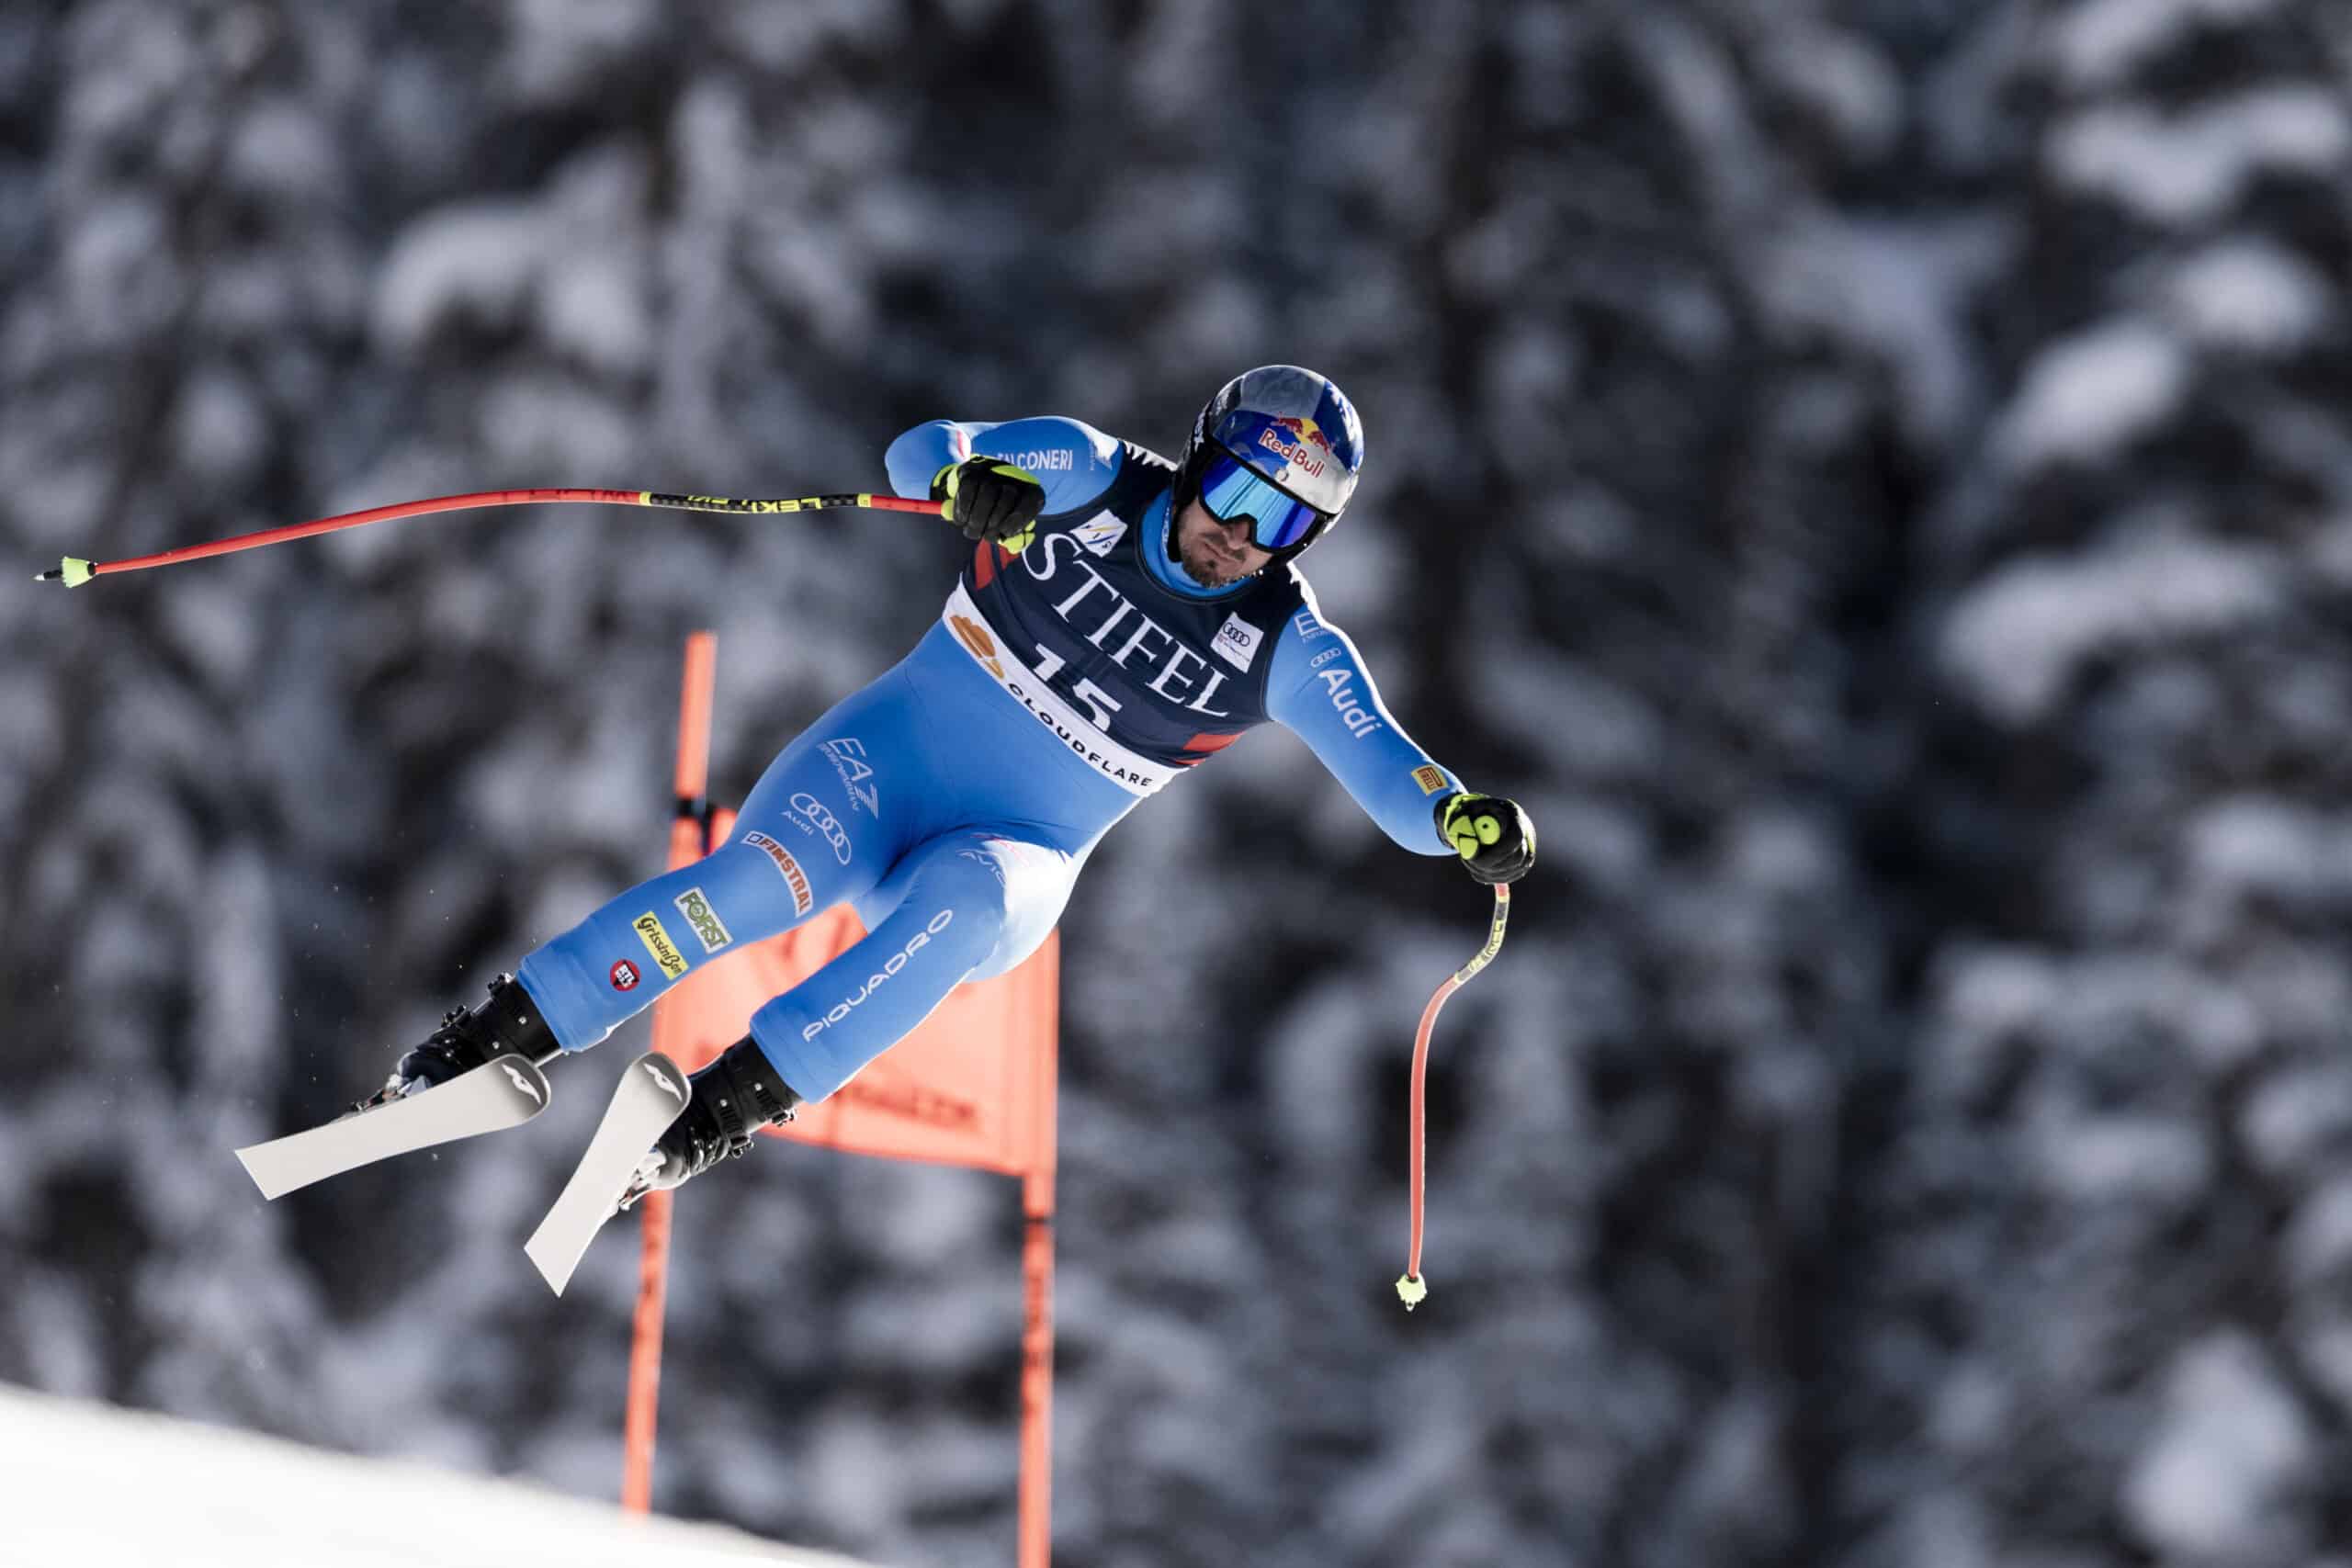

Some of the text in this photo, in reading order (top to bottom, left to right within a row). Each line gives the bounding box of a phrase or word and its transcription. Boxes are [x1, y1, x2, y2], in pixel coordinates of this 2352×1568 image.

[1259, 428, 1325, 479] Red Bull
[752, 497, 823, 513] LEKI
[1022, 533, 1229, 717] STIFEL
[1033, 643, 1123, 732] 15
[1318, 669, 1383, 739] Audi
[1008, 682, 1152, 786] CLOUDFLARE
[781, 809, 815, 836] Audi
[758, 837, 811, 914] FINSTRAL
[637, 917, 683, 974] GrissinBon
[680, 891, 729, 949] FORST
[802, 908, 954, 1043] PIQUADRO
